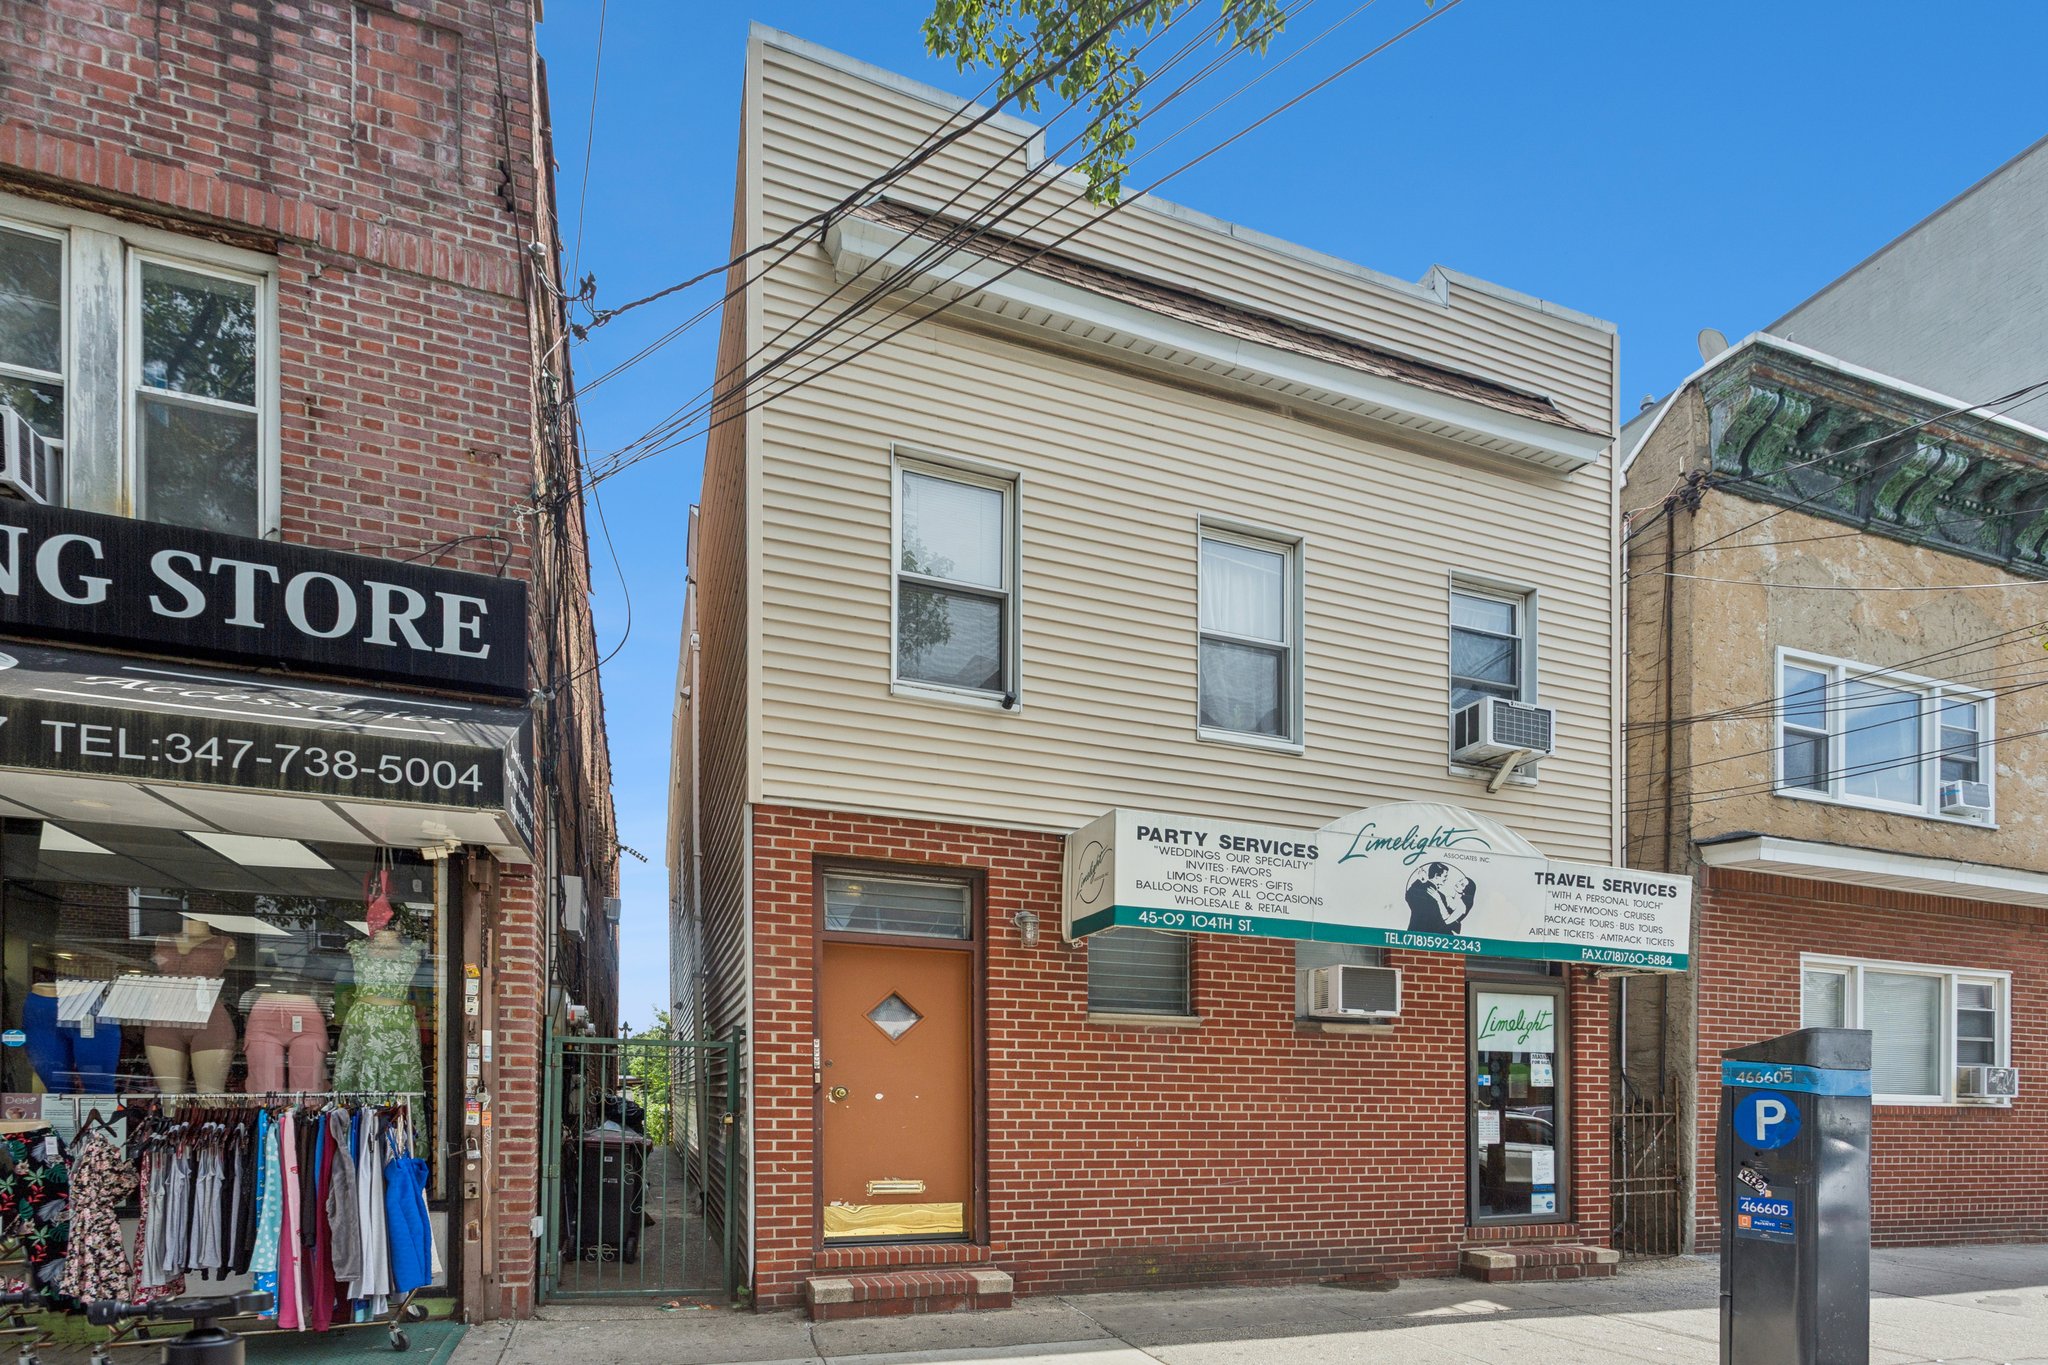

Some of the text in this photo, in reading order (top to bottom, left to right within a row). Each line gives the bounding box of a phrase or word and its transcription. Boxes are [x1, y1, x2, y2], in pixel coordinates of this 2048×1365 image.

[149, 549, 490, 660] STORE
[73, 676, 460, 725] Accessories
[41, 719, 483, 793] TEL:347-738-5004
[1137, 826, 1319, 860] PARTY SERVICES
[1338, 822, 1491, 865] Limelight
[1154, 845, 1313, 870] "WEDDINGS OUR SPECIALTY"
[1443, 852, 1478, 862] ASSOCIATES
[1186, 860, 1272, 878] INVITES FAVORS
[1167, 871, 1293, 892] LIMOS FLOWERS GIFTS
[1534, 872, 1677, 898] TRAVEL SERVICES
[1136, 880, 1323, 906] BALLOONS FOR ALL OCCASIONS
[1575, 893, 1582, 901] A
[1586, 894, 1629, 907] PERSONAL
[1174, 895, 1290, 915] WHOLESALE & RETAIL
[1554, 903, 1655, 921] HONEYMOONS CRUISES
[1138, 911, 1254, 932] 45-09 104TH ST.
[1544, 915, 1663, 934] PACKAGE TOURS BUS TOURS
[1529, 927, 1675, 947] AIRLINE TICKETS AMTRACK TICKETS
[1478, 1006, 1553, 1045] Limelight
[1736, 1071, 1793, 1085] 466605
[1755, 1099, 1787, 1141] P
[1741, 1201, 1789, 1217] 466605
